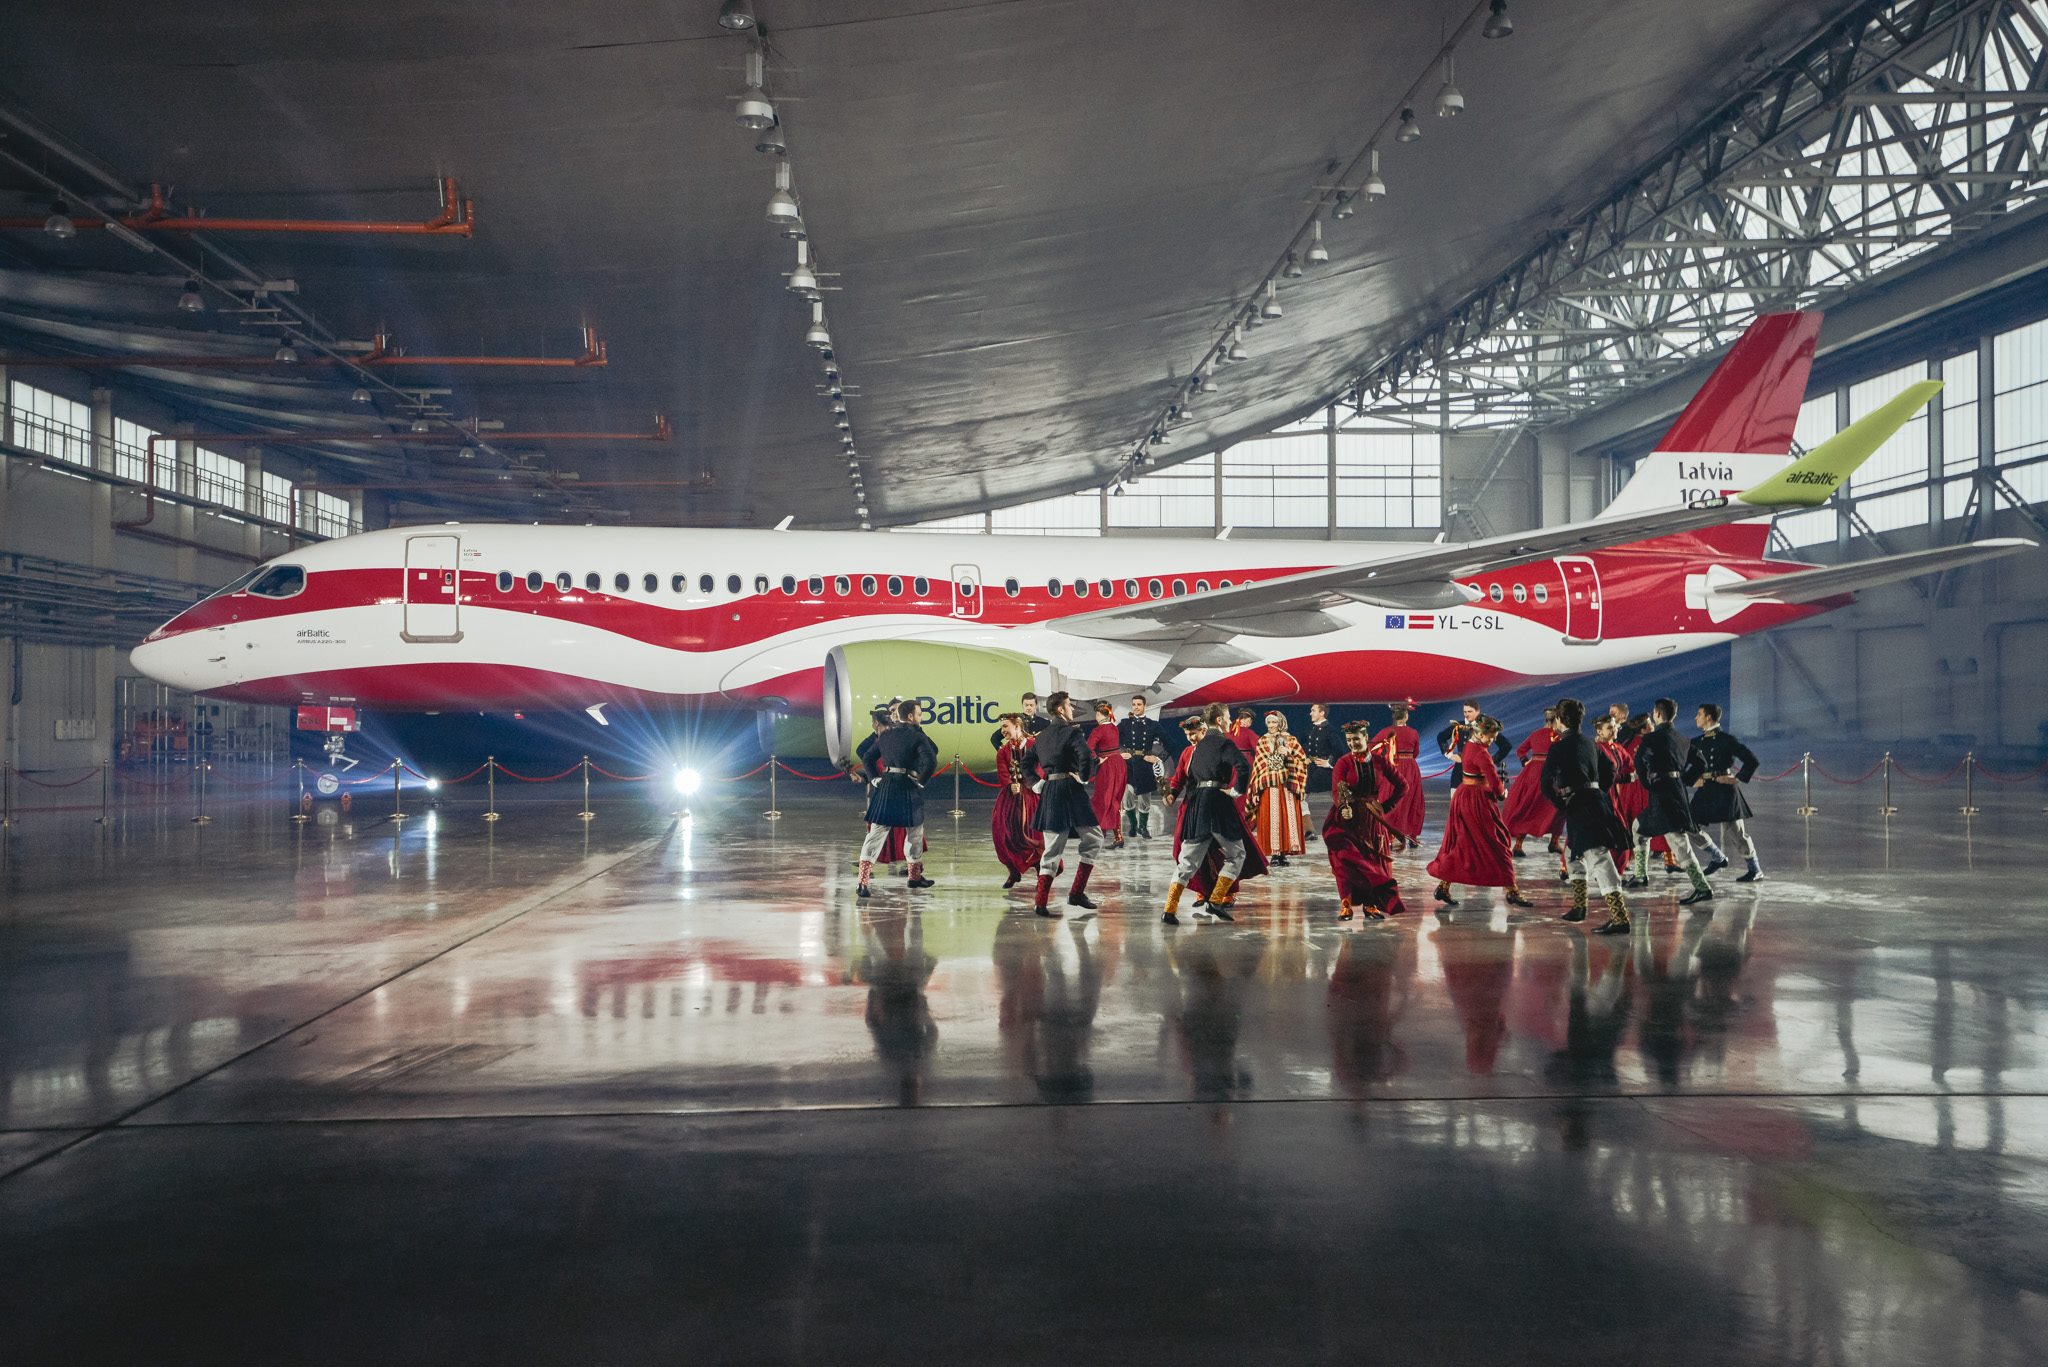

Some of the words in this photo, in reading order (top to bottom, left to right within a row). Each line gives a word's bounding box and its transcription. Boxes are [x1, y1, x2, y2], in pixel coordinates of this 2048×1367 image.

[1678, 461, 1733, 480] Latvia
[1786, 471, 1839, 486] airBaltic
[1438, 615, 1504, 630] YL-CSL
[296, 629, 331, 638] airBaltic
[874, 695, 1001, 725] Baltic
